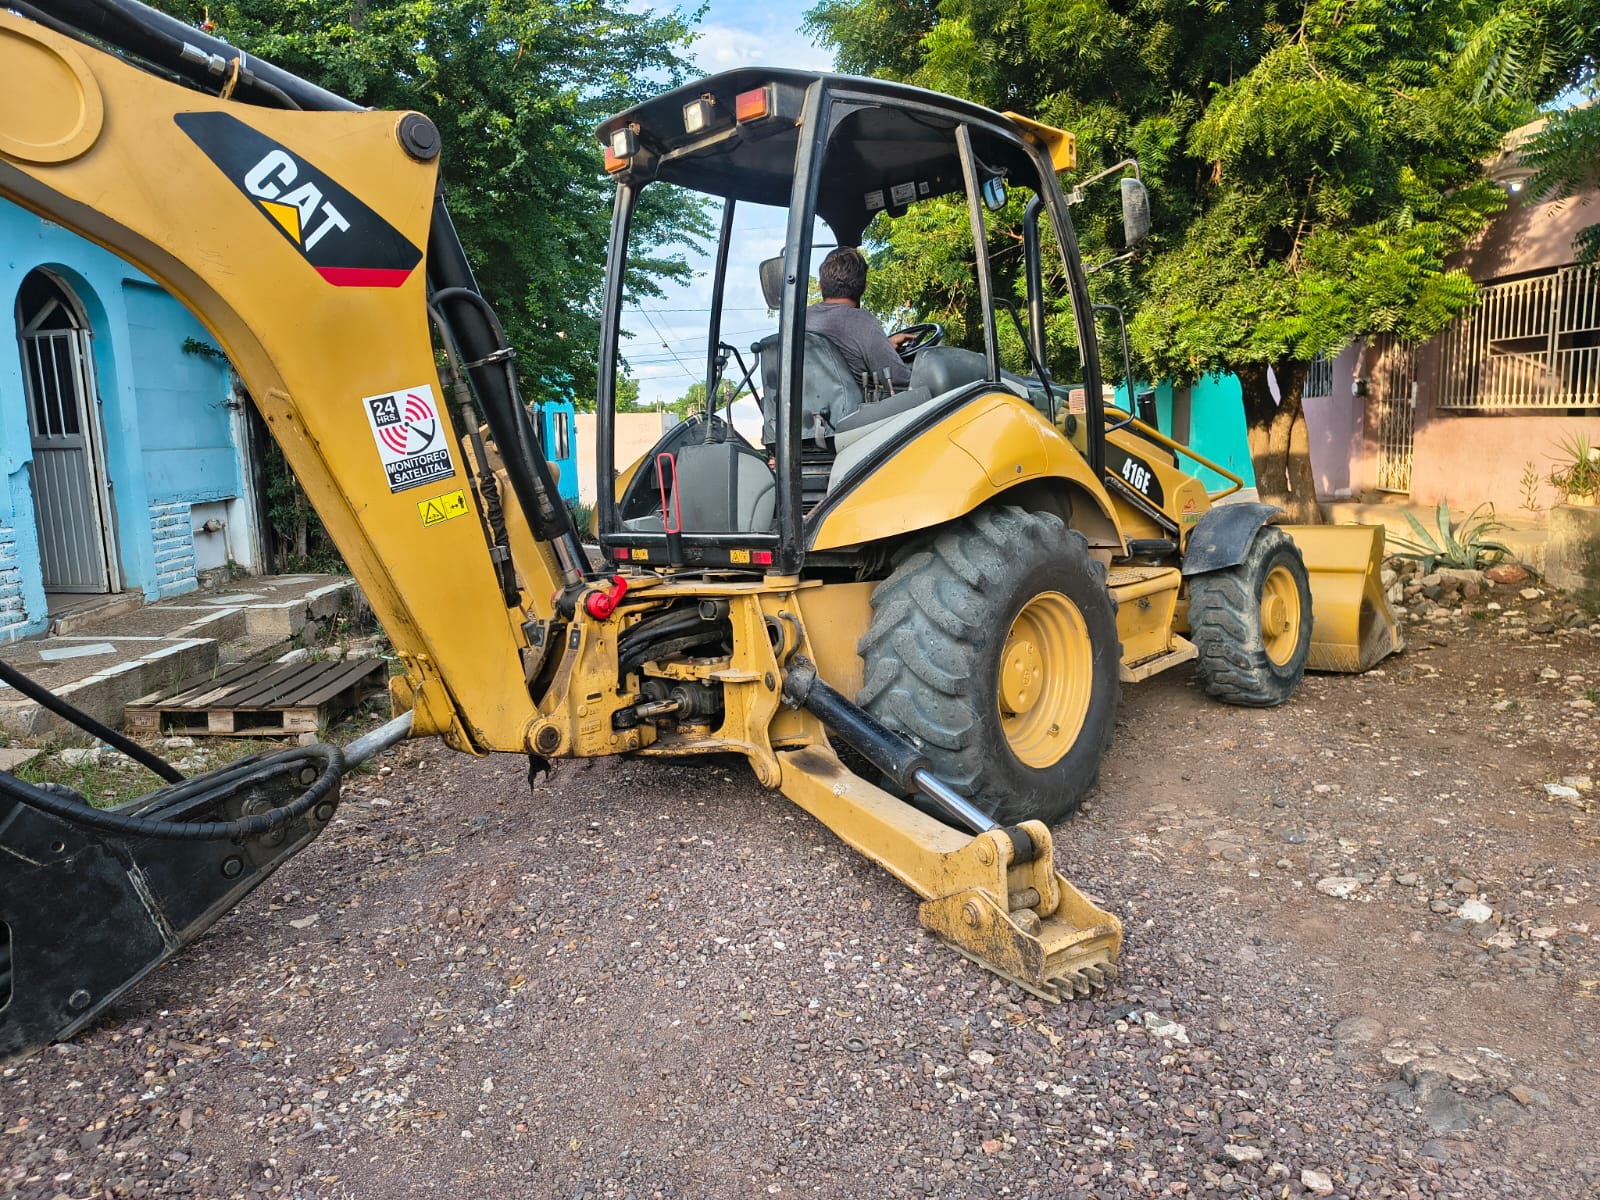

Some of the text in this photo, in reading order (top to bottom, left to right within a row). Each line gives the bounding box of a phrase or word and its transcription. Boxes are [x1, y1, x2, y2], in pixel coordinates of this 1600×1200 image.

[244, 150, 351, 252] CAT
[373, 399, 395, 416] 24
[376, 413, 399, 424] HRS.
[387, 450, 448, 474] MONITOREO
[394, 462, 448, 483] SATELITAL
[1122, 458, 1151, 495] 416E
